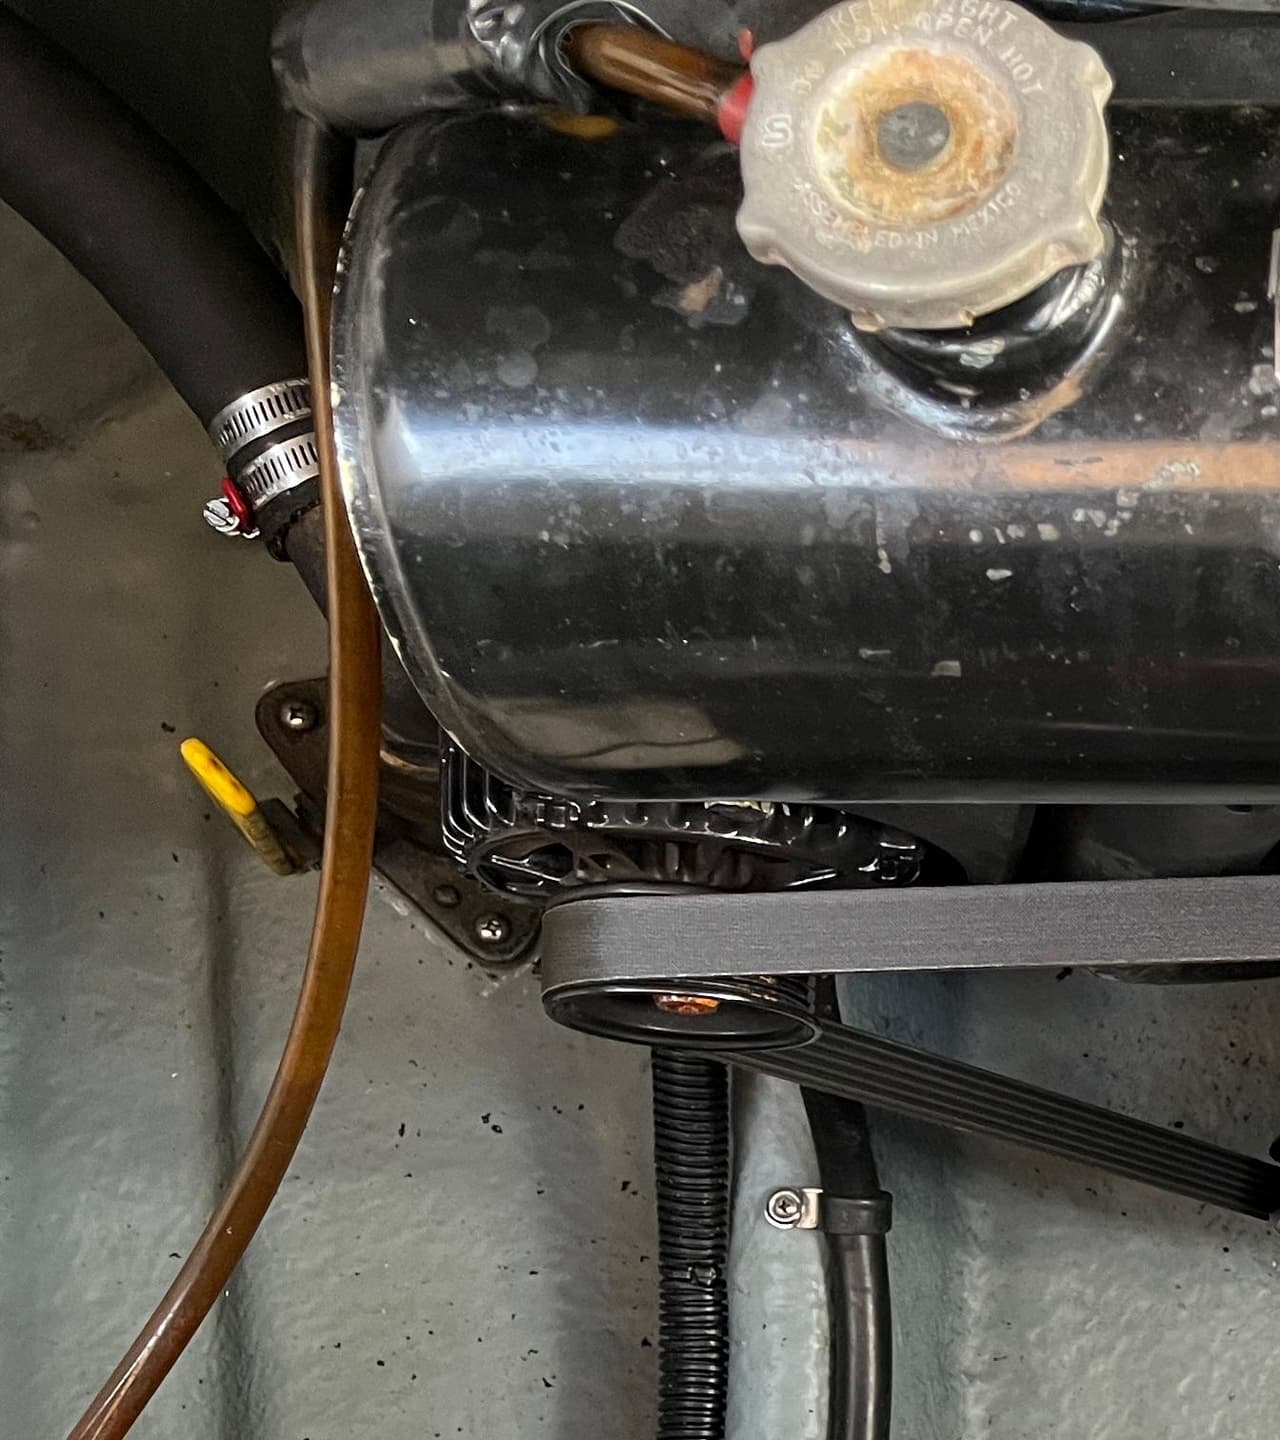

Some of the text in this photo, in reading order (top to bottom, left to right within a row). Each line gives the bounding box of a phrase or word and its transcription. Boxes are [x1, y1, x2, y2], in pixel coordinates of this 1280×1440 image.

[933, 0, 1018, 31] IGHT
[914, 11, 993, 46] OPEN
[1000, 46, 1046, 94] HOT
[951, 181, 1021, 238] MEXICO
